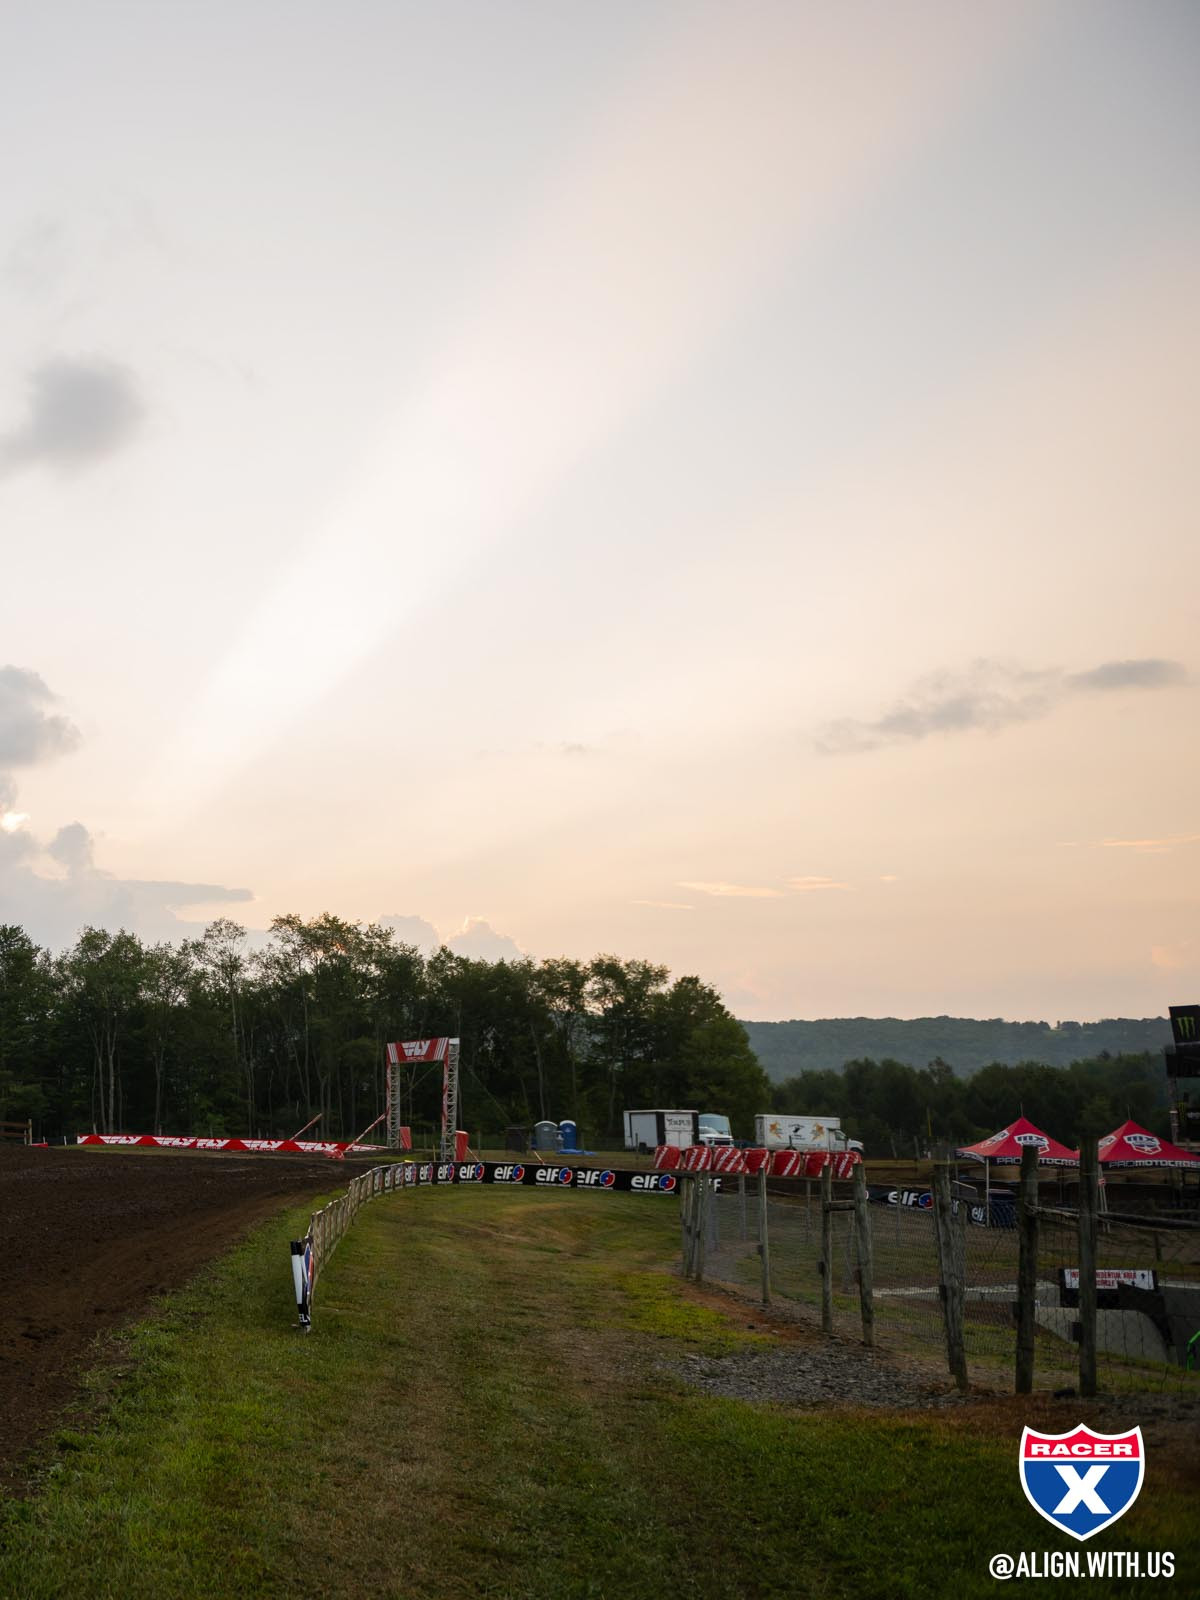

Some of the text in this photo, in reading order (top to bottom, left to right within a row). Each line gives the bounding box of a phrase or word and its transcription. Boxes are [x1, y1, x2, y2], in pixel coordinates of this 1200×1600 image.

[459, 1164, 476, 1179] elf
[493, 1165, 514, 1180] elf
[535, 1167, 560, 1182] elf
[630, 1174, 659, 1189] elf
